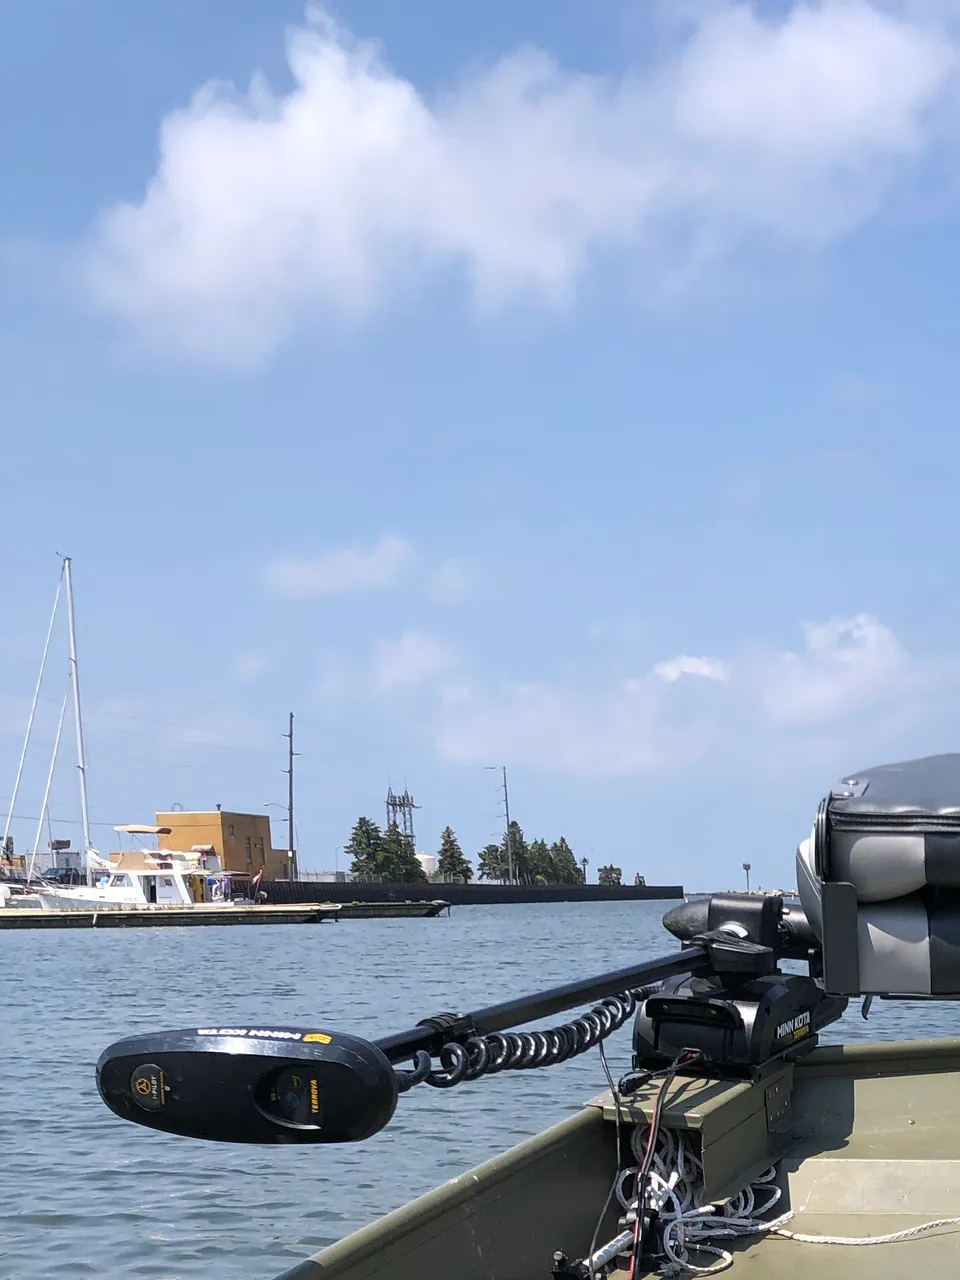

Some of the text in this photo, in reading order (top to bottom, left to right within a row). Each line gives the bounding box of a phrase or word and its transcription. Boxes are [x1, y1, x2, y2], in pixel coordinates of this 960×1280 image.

[777, 1018, 794, 1039] MINN
[794, 1010, 810, 1030] KOTA
[310, 1079, 319, 1114] TERROVA
